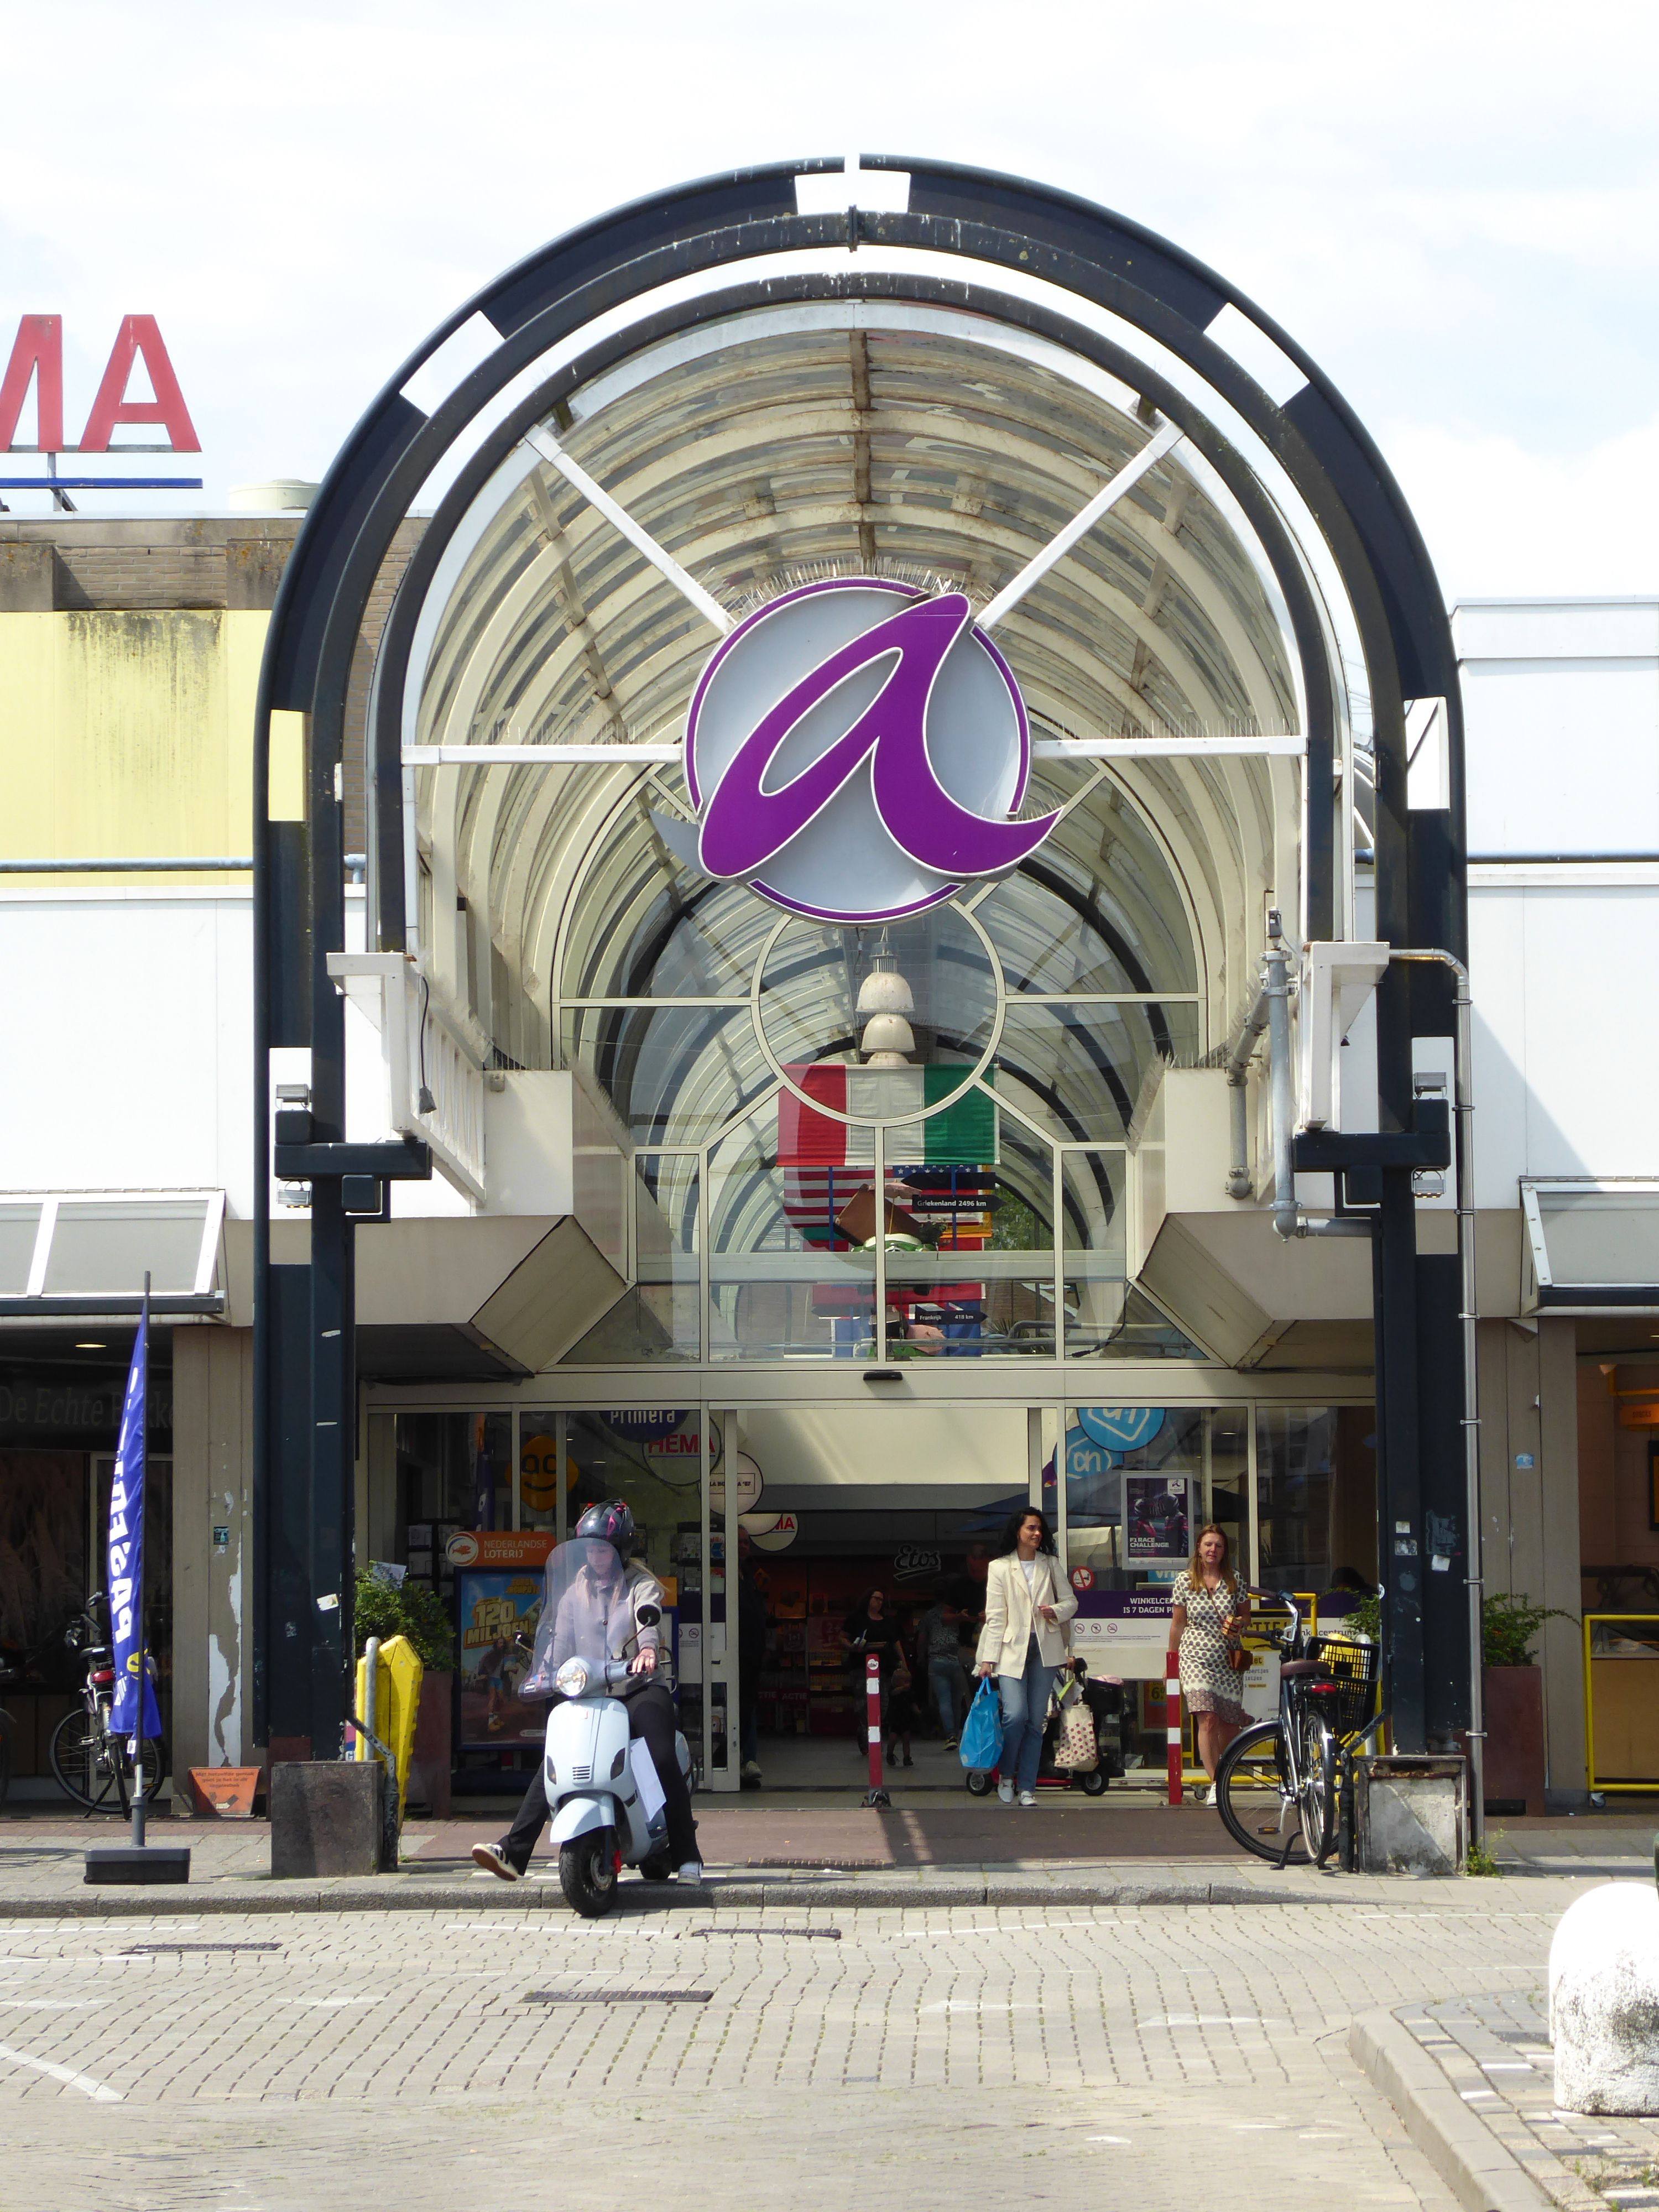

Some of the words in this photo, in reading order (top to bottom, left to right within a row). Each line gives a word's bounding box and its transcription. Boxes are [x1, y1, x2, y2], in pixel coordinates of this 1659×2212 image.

[917, 1199, 957, 1207] Griekenland
[976, 1199, 987, 1207] km
[34, 1386, 104, 1426] Echte
[483, 1540, 547, 1548] NEDERLANDSE
[484, 1550, 524, 1559] LOTERIJ
[894, 1544, 941, 1570] Etos
[476, 1600, 515, 1628] 120
[466, 1619, 530, 1645] MILJOEN
